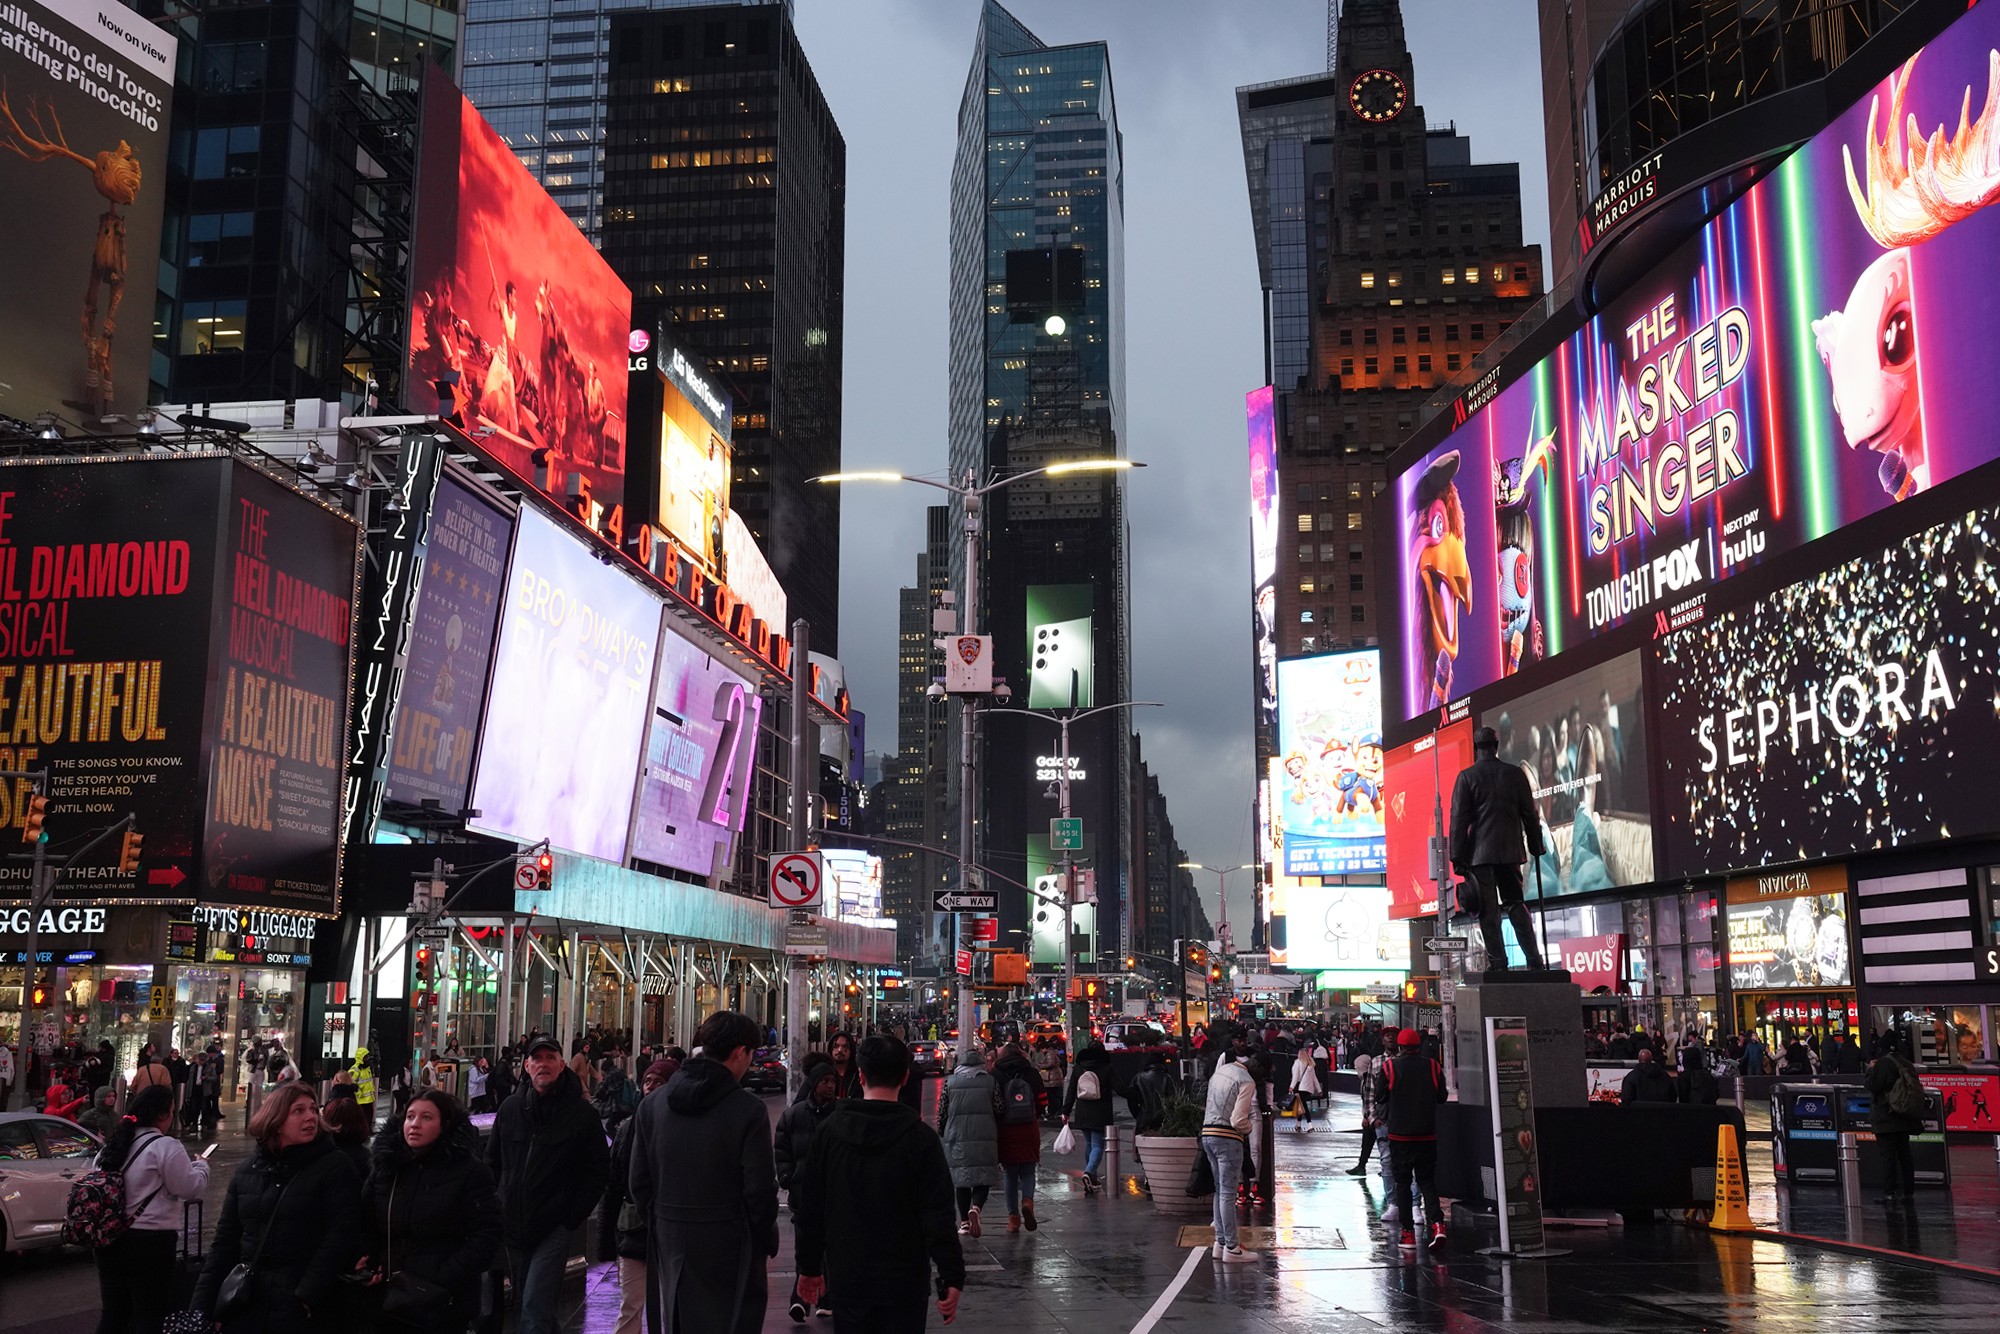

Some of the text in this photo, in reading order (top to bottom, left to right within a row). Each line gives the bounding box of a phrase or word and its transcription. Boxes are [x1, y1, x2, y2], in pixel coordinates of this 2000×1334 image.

[98, 12, 167, 64] Now on view
[0, 28, 158, 132] afting Pinocchio
[84, 53, 113, 83] del
[117, 69, 162, 113] Toro:
[1595, 153, 1663, 216] MARRIOTT
[1596, 181, 1654, 236] MARQUIS
[1626, 292, 1676, 363] THE
[628, 357, 648, 371] LG
[673, 348, 685, 377] LG
[1468, 366, 1501, 400] MARRIOTT
[1578, 306, 1751, 480] MASKED
[1468, 383, 1498, 414] MARQUIS
[1590, 408, 1749, 554] SINGER
[241, 497, 270, 561] THE
[445, 509, 497, 554] BELIEVE IN THE
[1723, 509, 1759, 537] NEXT DAY
[433, 523, 459, 553] POWER
[459, 539, 469, 557] OF
[1721, 529, 1766, 569] hulu
[29, 541, 190, 599] DIAMOND
[1586, 538, 1702, 630] TONIGHT FOX
[233, 552, 349, 647] NEIL DIAMOND
[1670, 594, 1707, 616] MARRIOTT
[518, 567, 648, 676] BROADWAY'S
[664, 542, 820, 694] BROADWY
[1671, 607, 1704, 629] MARQUIS
[229, 606, 296, 680] MUSICAL
[221, 667, 336, 769] A BEAUTIFUL
[1449, 696, 1471, 712] MARRIOTT
[1450, 708, 1469, 721] MARQUIS
[1699, 648, 1956, 773] SEPHORA
[394, 705, 473, 785] LIFE OF PI
[54, 757, 183, 769] THE SONGS YOU KNOW.
[280, 770, 305, 781] FEATURING
[305, 775, 314, 783] ALL
[1036, 769, 1086, 780] S23 Utra
[51, 786, 133, 797] NEVER HEARD,
[52, 774, 157, 785] THE STORY YOU'VE
[215, 745, 276, 832] NOISE
[279, 778, 329, 795] HIT SONGS INCLUDING
[1553, 773, 1602, 794] STORY EVER WORN
[85, 803, 115, 812] NOW.
[1290, 846, 1370, 861] GET TICKETS
[0, 868, 62, 879] DHUT
[275, 879, 286, 888] GET
[287, 880, 309, 892] TICKETS
[1758, 872, 1811, 895] INVICTA
[942, 897, 990, 906] ONE WAY
[192, 906, 238, 933] GIFTS
[250, 911, 316, 939] LUGGAGE
[1729, 920, 1747, 935] THE
[215, 951, 235, 961] Nikon
[254, 936, 270, 949] NY
[1730, 935, 1786, 953] COLLECTION
[267, 953, 290, 964] SONY
[292, 955, 311, 964] BOWER
[151, 988, 162, 1017] ATM
